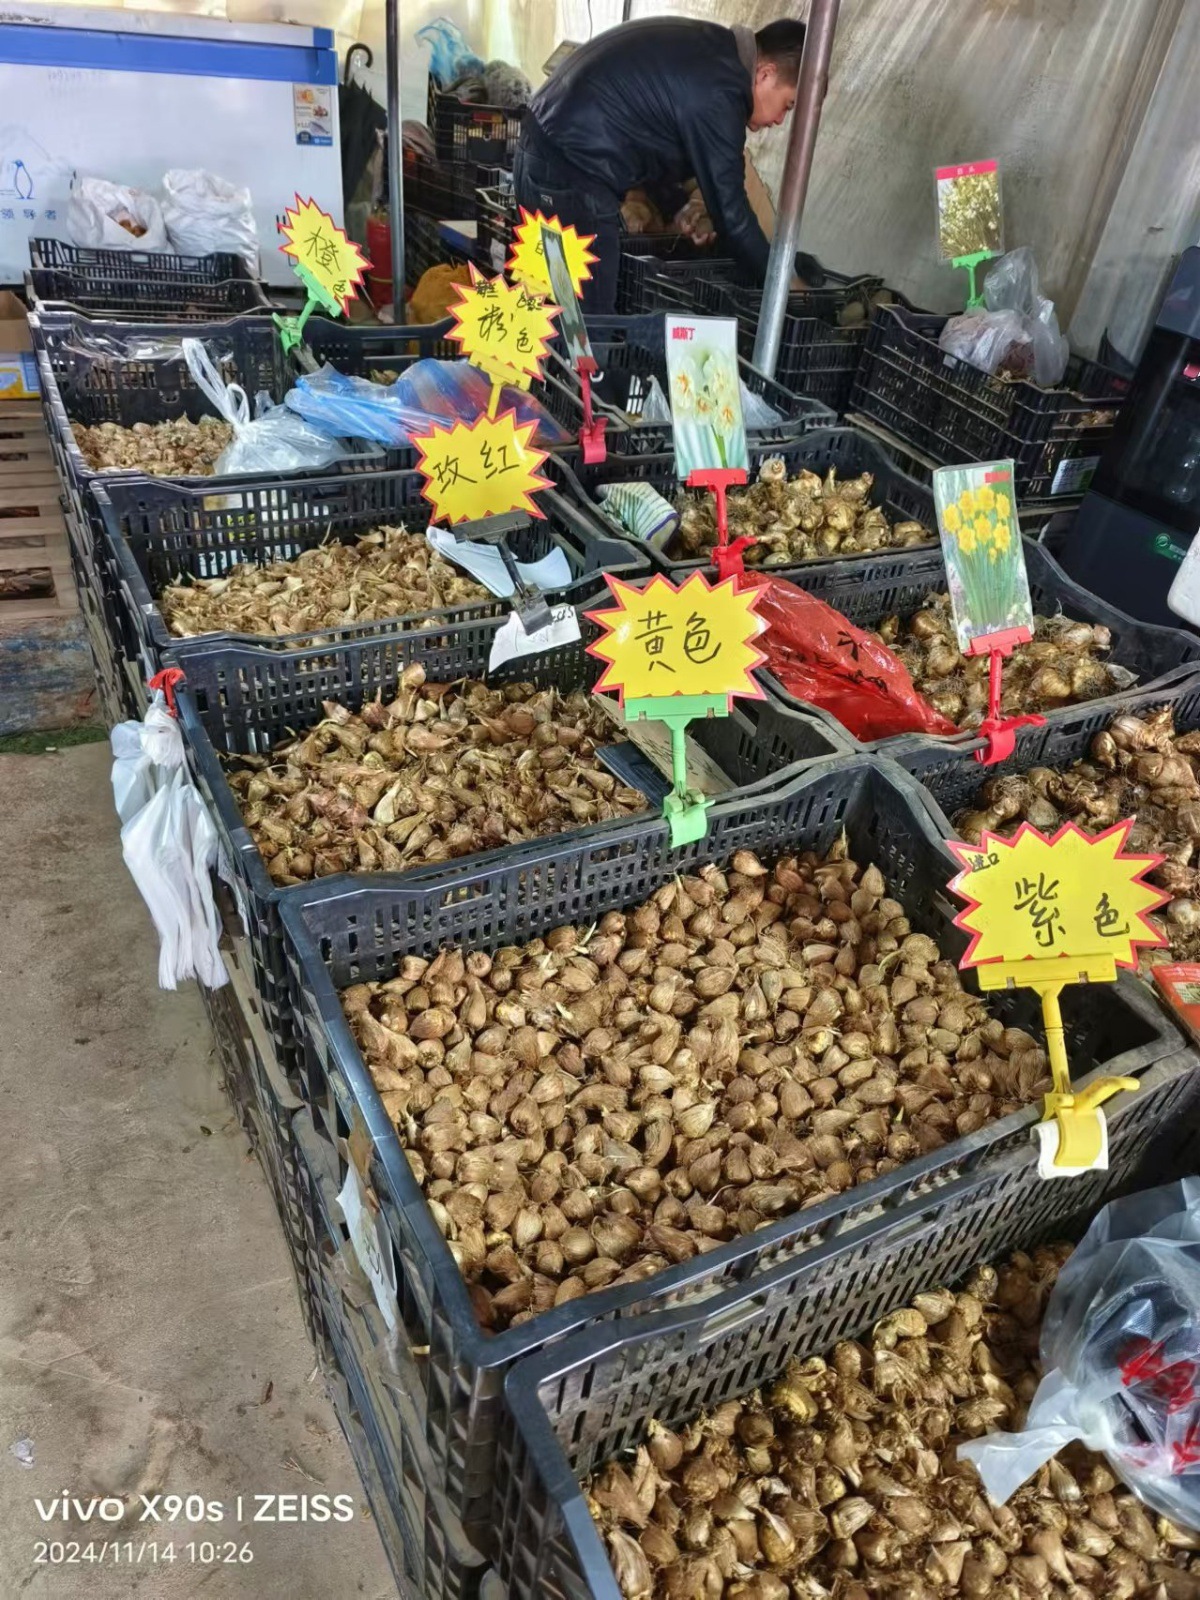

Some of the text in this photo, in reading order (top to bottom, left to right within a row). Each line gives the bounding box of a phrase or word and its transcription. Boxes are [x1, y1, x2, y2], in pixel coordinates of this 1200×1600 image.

[477, 304, 534, 354] 粉色
[432, 440, 520, 494] 玫红
[634, 610, 722, 674] 黄色
[968, 852, 1000, 872] 进口
[1013, 871, 1131, 948] 紫色
